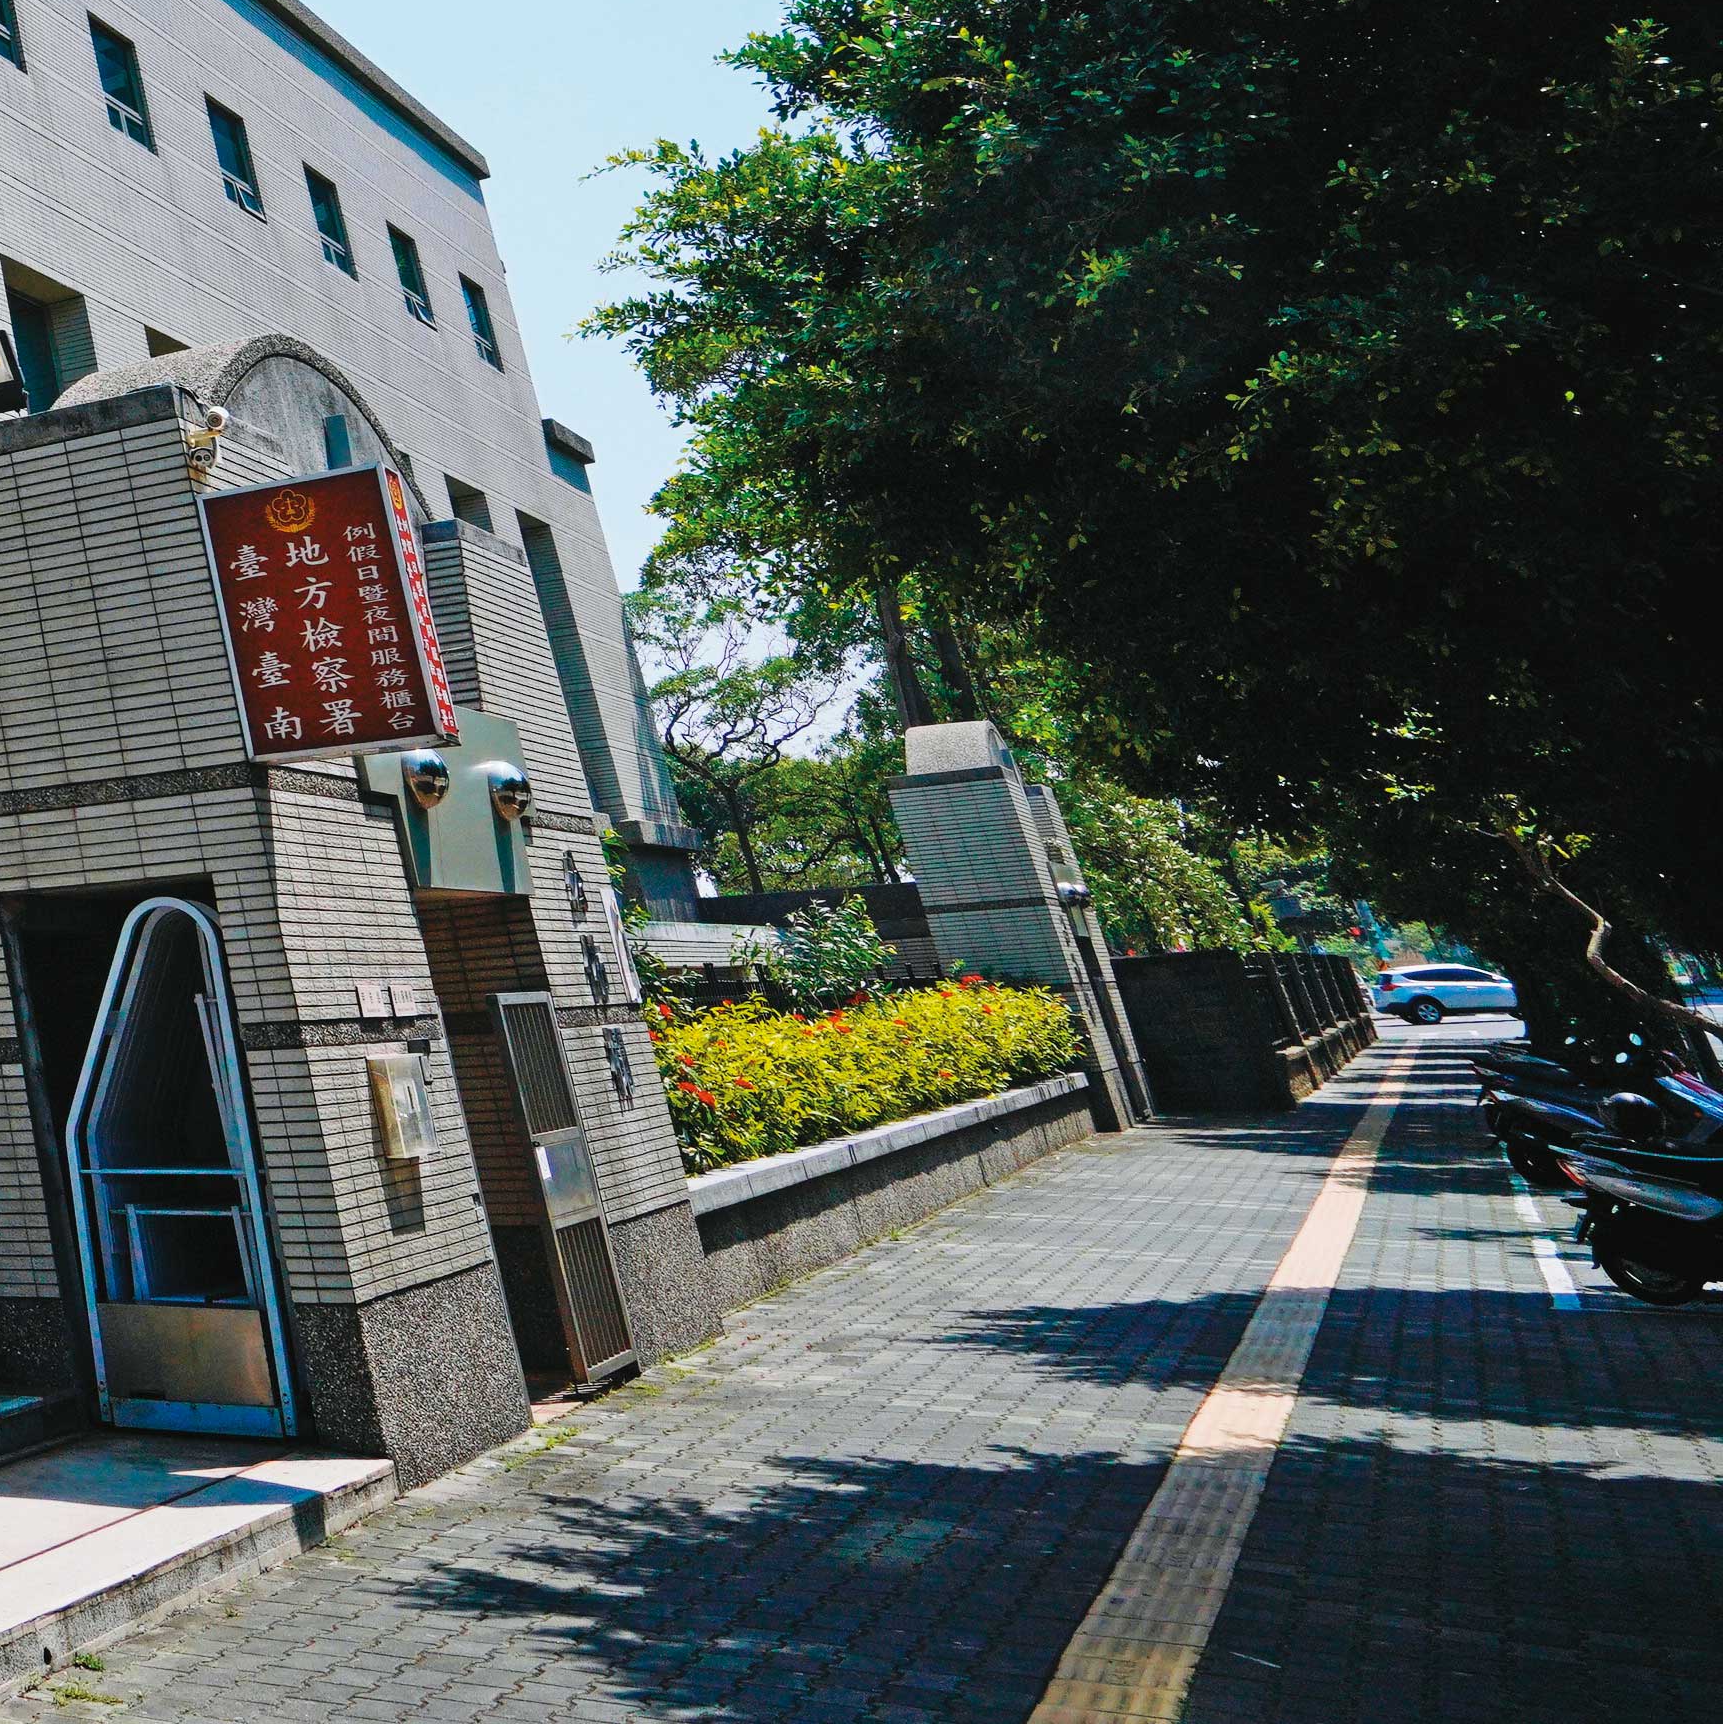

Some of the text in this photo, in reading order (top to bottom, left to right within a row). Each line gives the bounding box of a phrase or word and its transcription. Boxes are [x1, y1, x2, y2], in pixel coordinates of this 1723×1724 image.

[229, 542, 303, 741] 臺灣臺南
[284, 534, 364, 737] 地方檢察署
[342, 522, 417, 732] 例假日暨夜間服務櫃台
